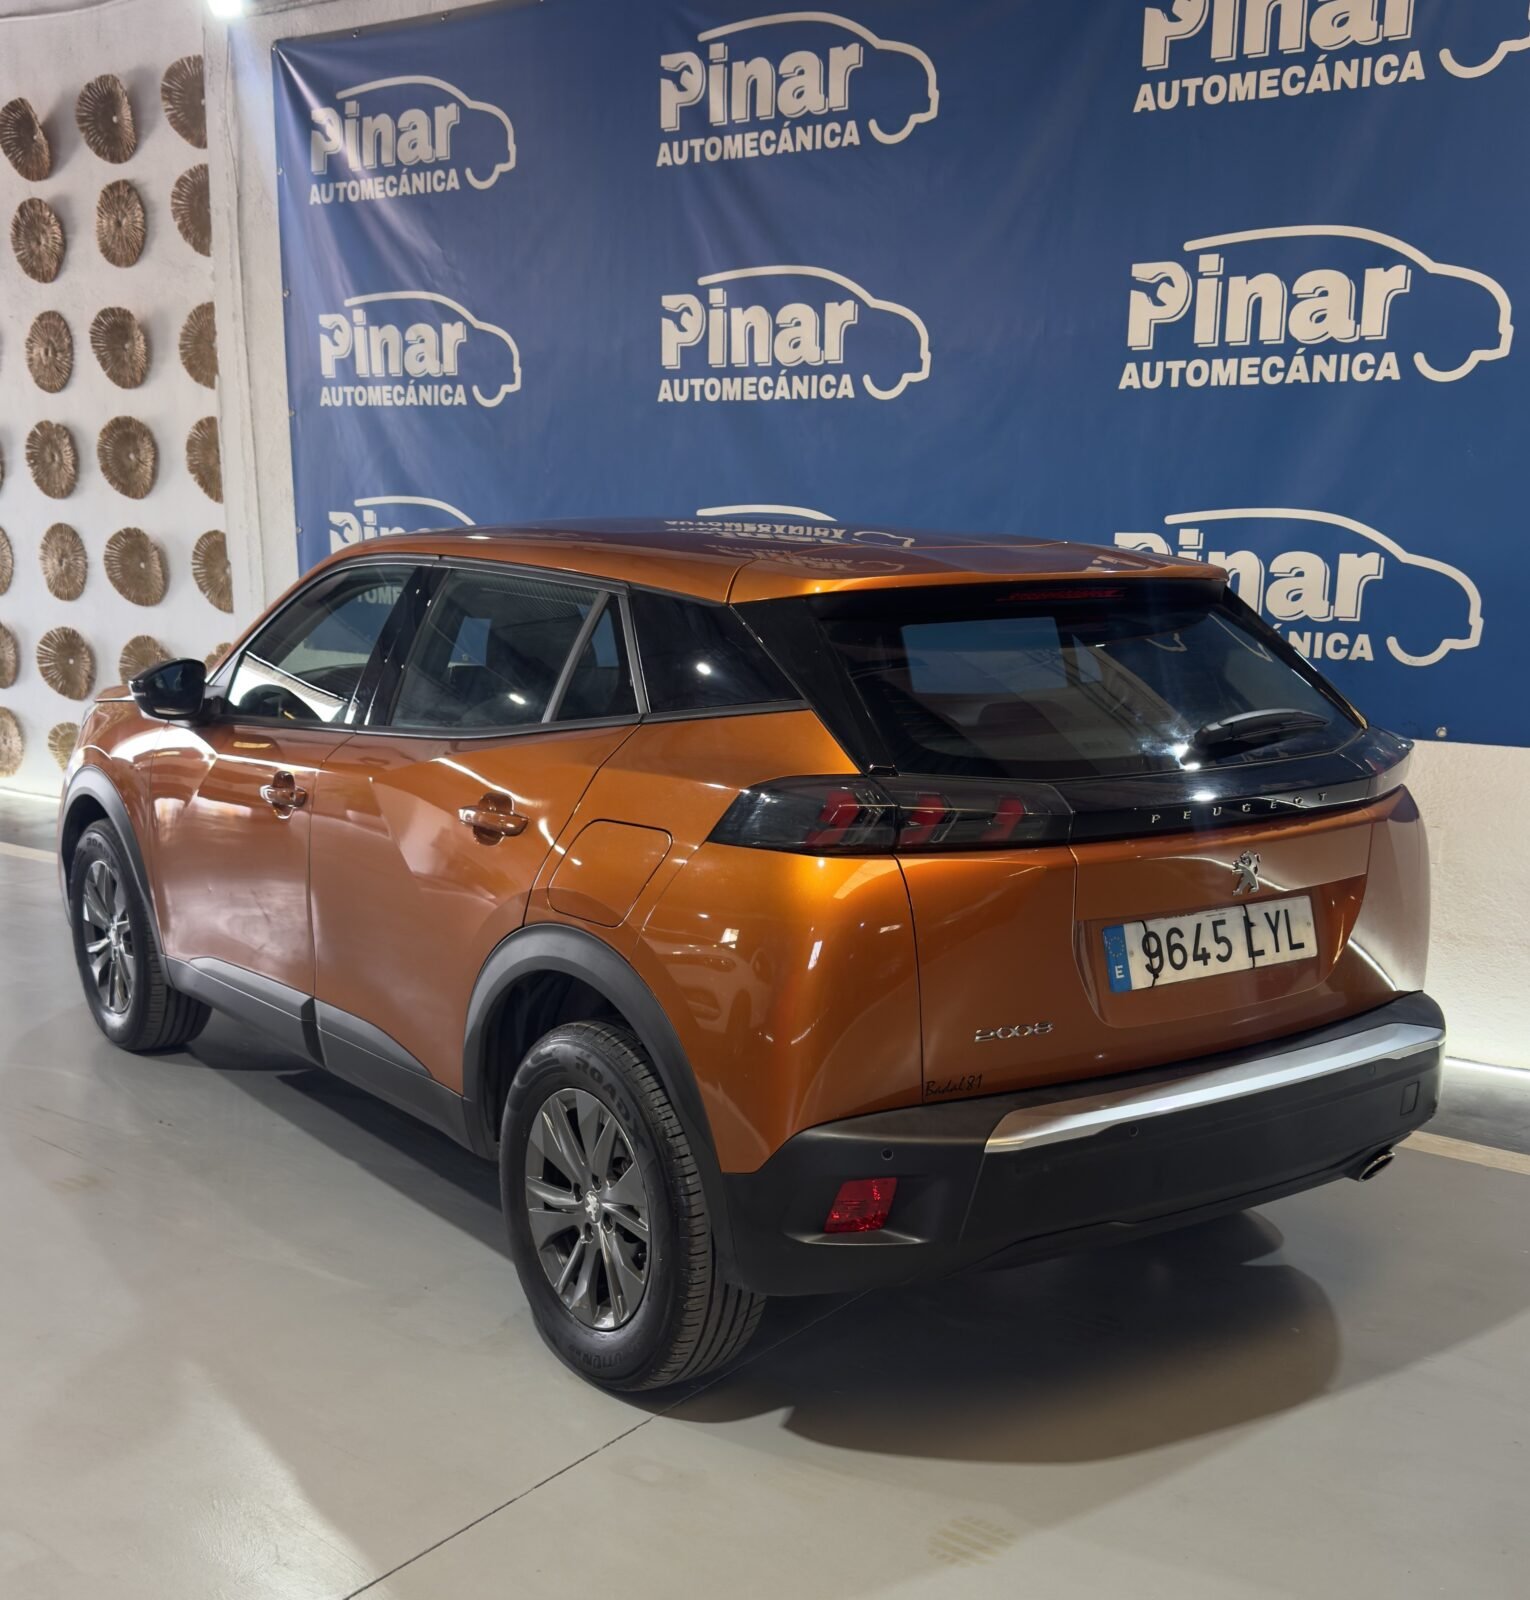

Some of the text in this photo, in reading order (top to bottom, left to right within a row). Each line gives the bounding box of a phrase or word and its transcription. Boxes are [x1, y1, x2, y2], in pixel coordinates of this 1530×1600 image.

[660, 42, 864, 131] Pinar
[1133, 50, 1425, 113] AUTOMECÁNICA
[310, 101, 460, 174] Pinar
[656, 119, 861, 167] AUTOMECÁNICA
[309, 167, 460, 206] AUTOMECÁNICA
[1127, 253, 1412, 351] Pinar
[318, 308, 467, 379] Pinar
[661, 288, 858, 370] Pinar
[657, 369, 855, 403] AUTOMECÁNICA
[1118, 347, 1401, 390] AUTOMECÁNICA
[319, 380, 468, 407] AUTOMECÁNICA
[1151, 791, 1328, 824] PEUGEOT
[1141, 908, 1305, 976] 9645 LYL
[1115, 964, 1125, 979] E
[974, 1022, 1054, 1043] 2008
